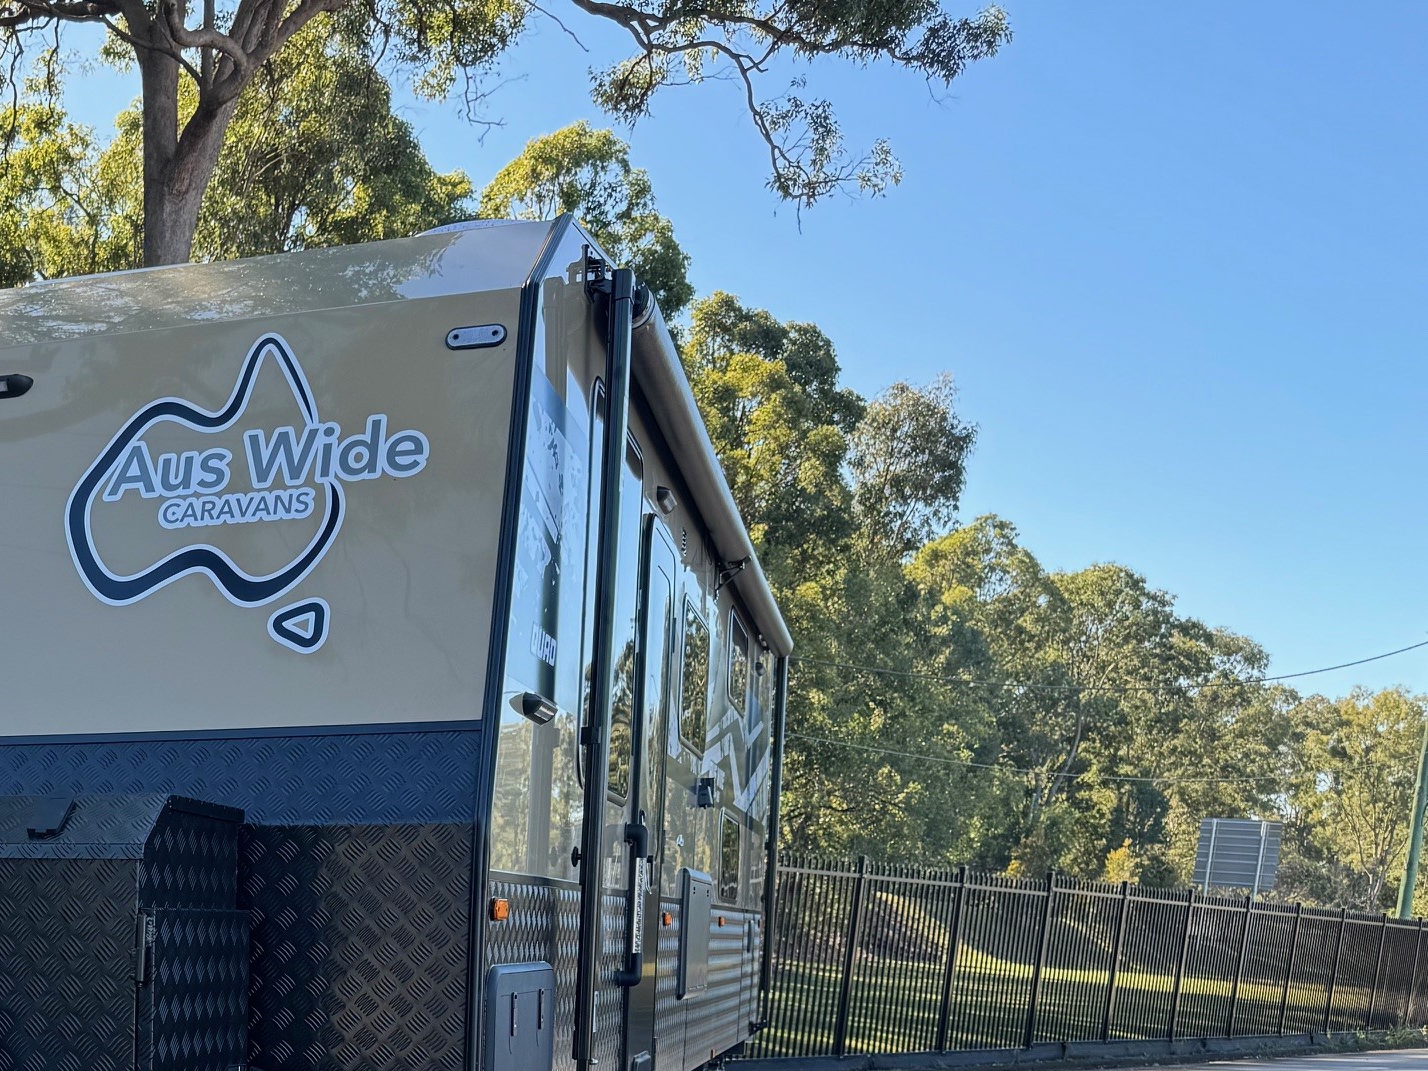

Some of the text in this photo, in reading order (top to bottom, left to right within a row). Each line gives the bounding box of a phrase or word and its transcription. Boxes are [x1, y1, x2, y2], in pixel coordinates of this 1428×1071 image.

[106, 417, 427, 498] Aus Wide
[160, 491, 312, 525] CARAVANS
